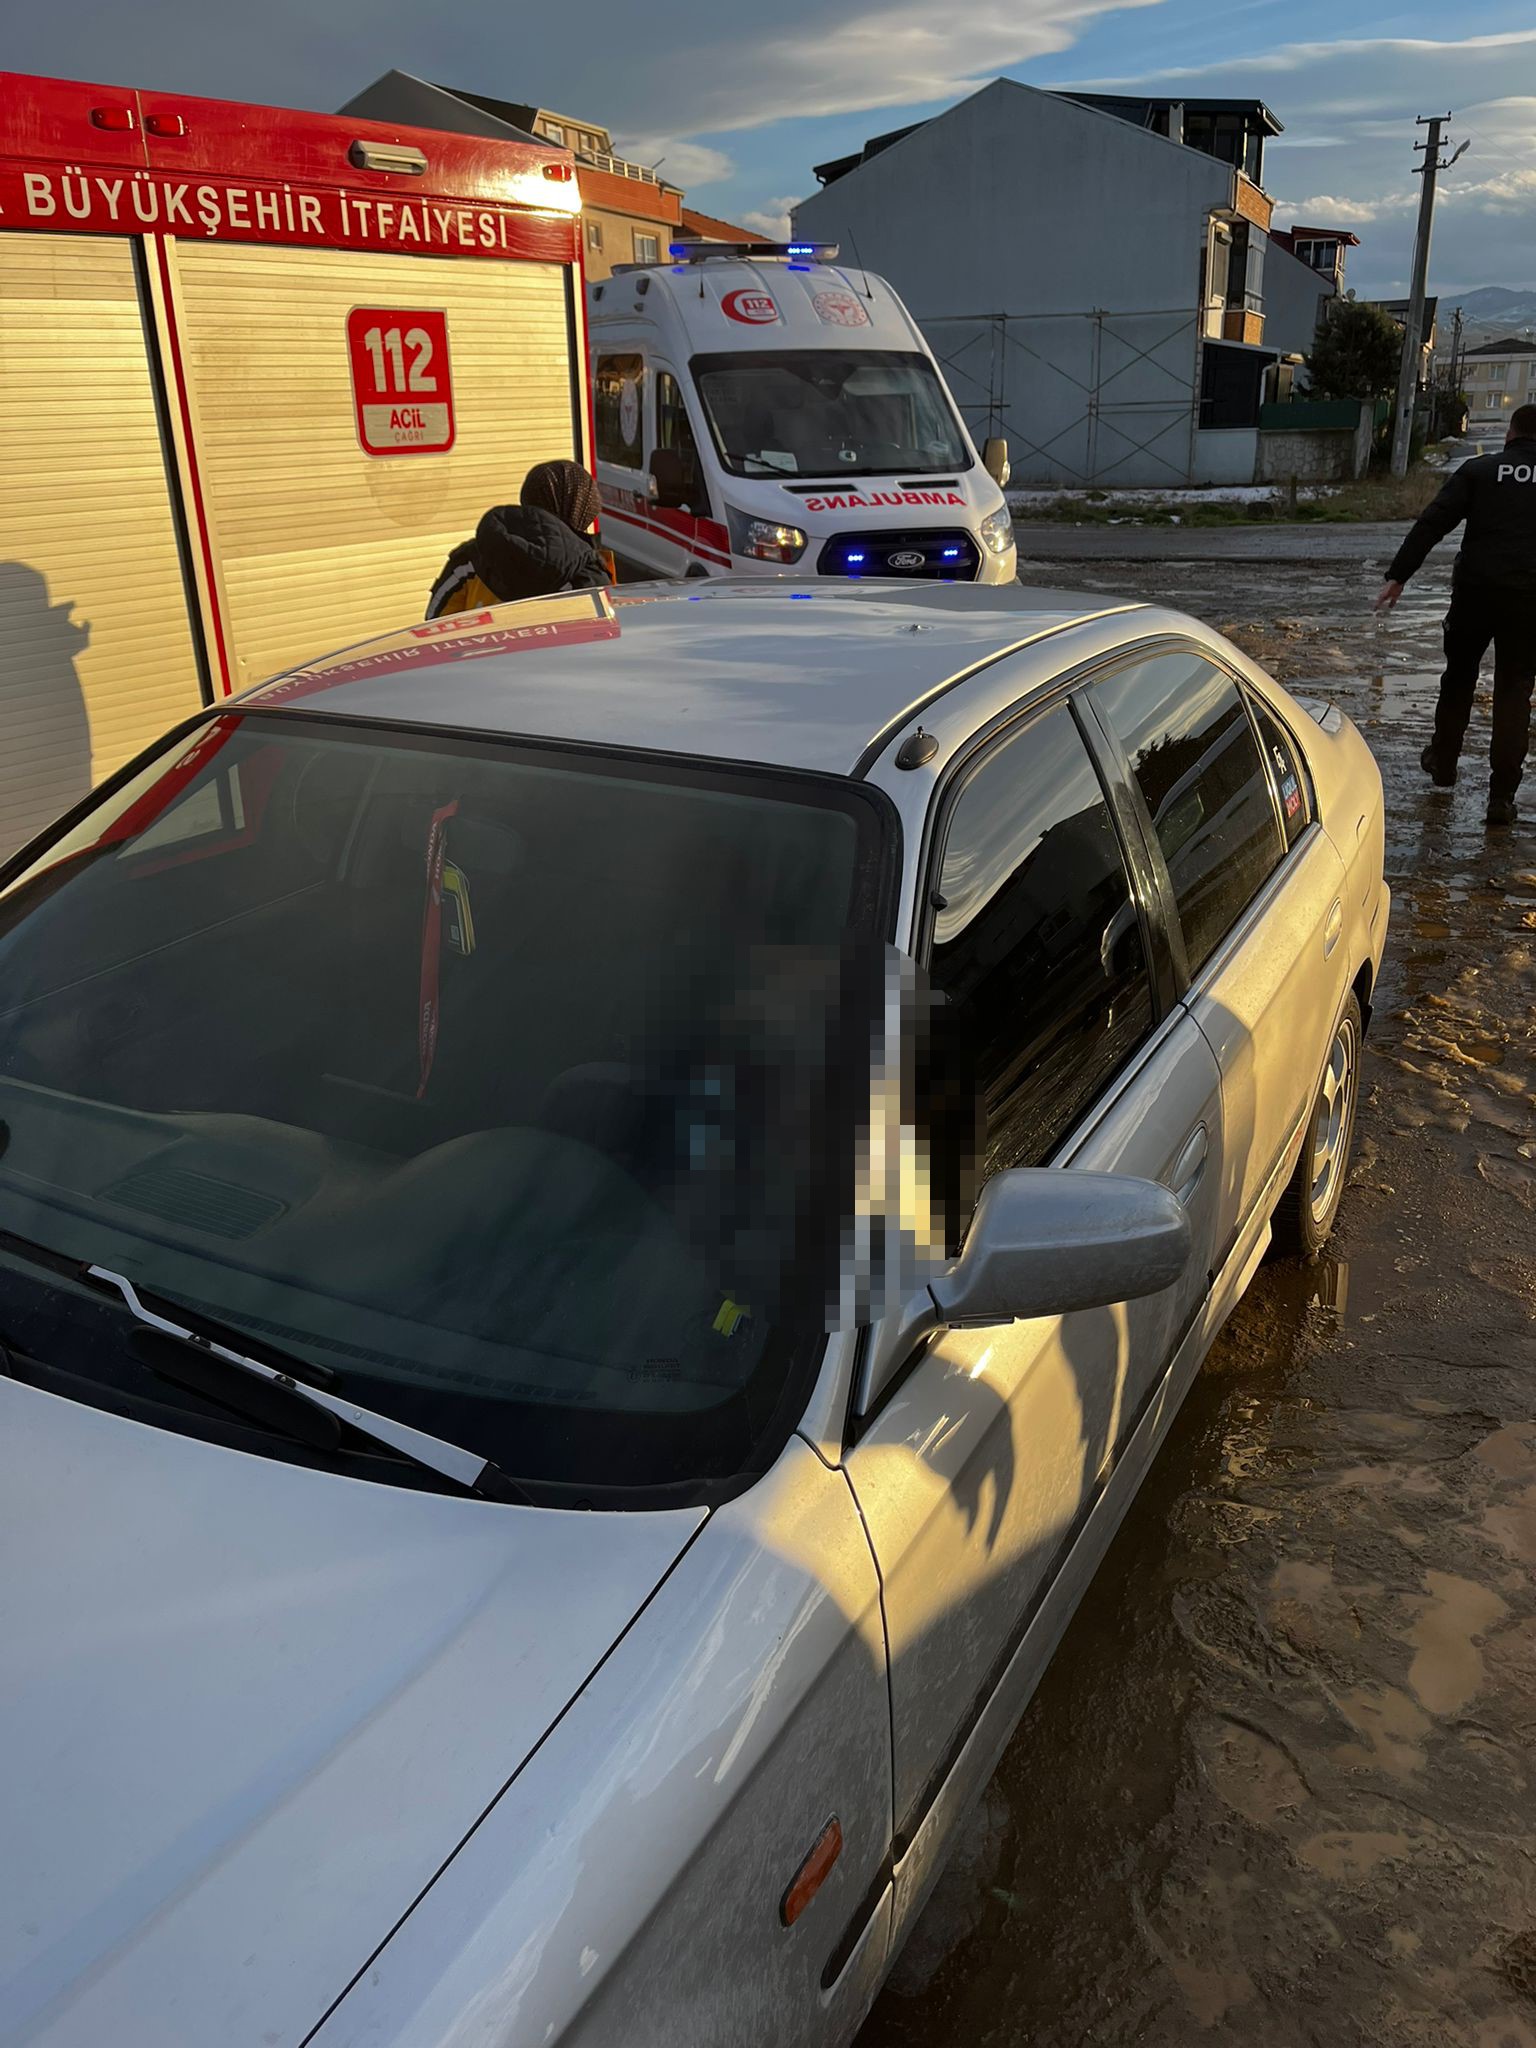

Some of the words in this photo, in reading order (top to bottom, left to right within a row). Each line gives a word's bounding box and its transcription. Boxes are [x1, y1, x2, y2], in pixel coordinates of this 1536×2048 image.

[23, 166, 325, 235] BÜYÜKŞEHİR
[746, 299, 771, 309] 112
[364, 327, 438, 393] 112
[894, 554, 918, 566] Ford
